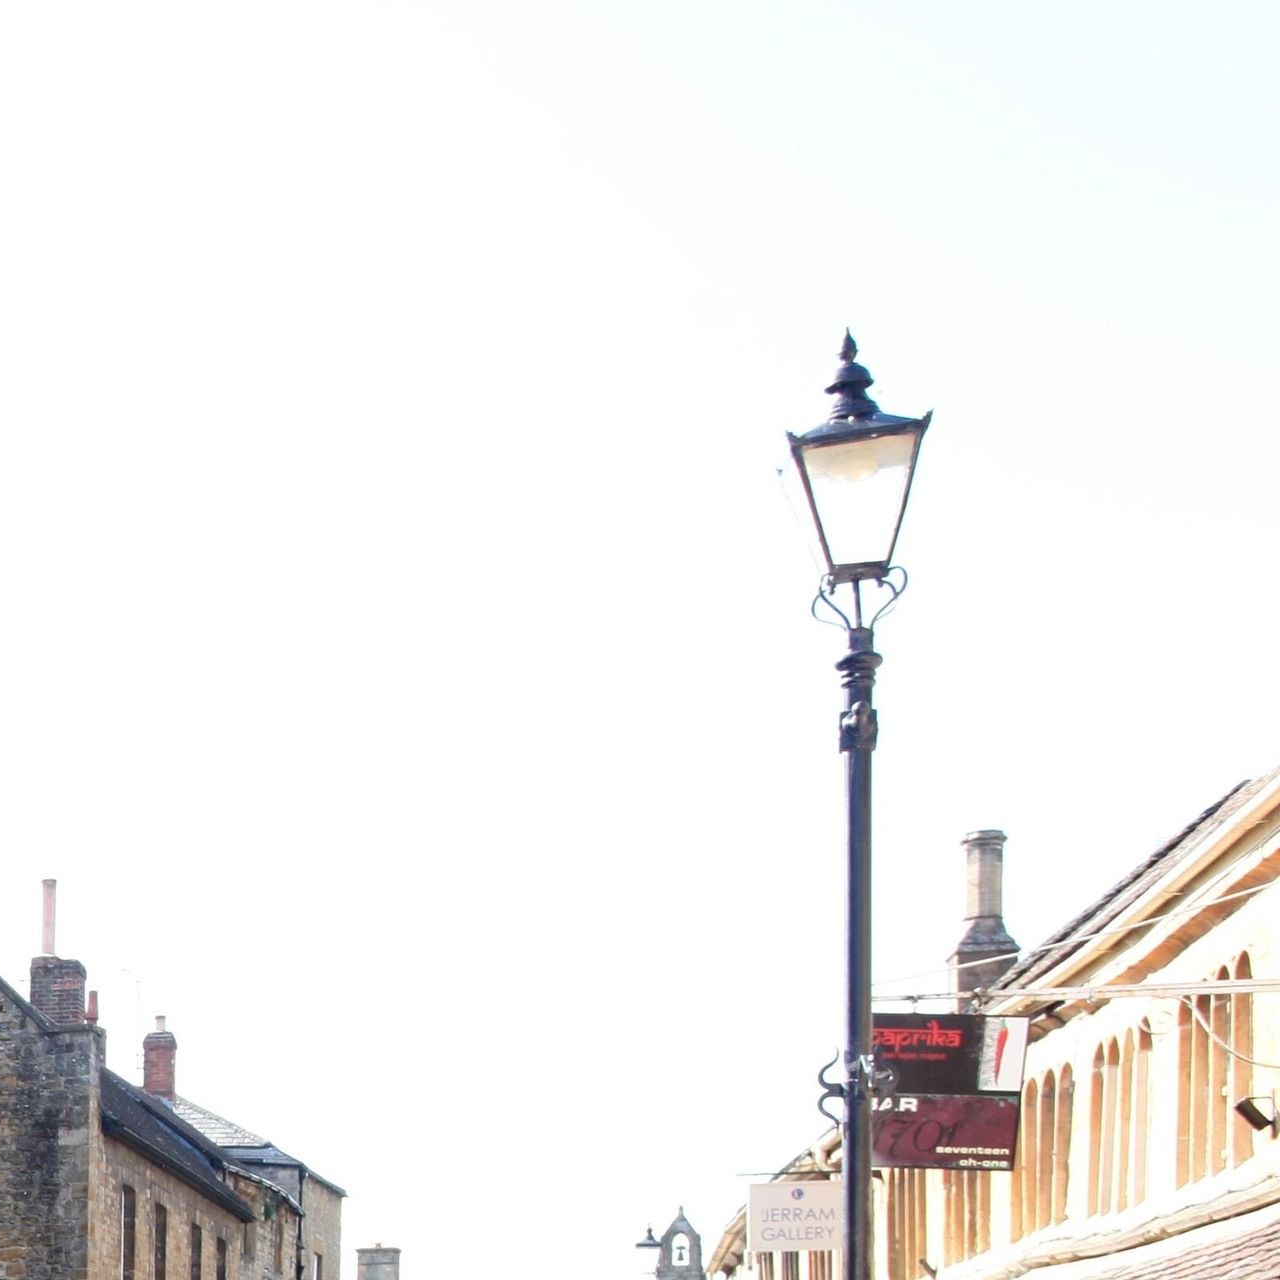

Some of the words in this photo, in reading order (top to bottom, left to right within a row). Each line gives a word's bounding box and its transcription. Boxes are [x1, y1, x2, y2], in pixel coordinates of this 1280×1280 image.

[936, 1146, 1009, 1155] seventeen
[959, 1158, 1008, 1168] oh-one
[762, 1207, 836, 1223] JERRAM
[761, 1226, 835, 1242] GALLERY
